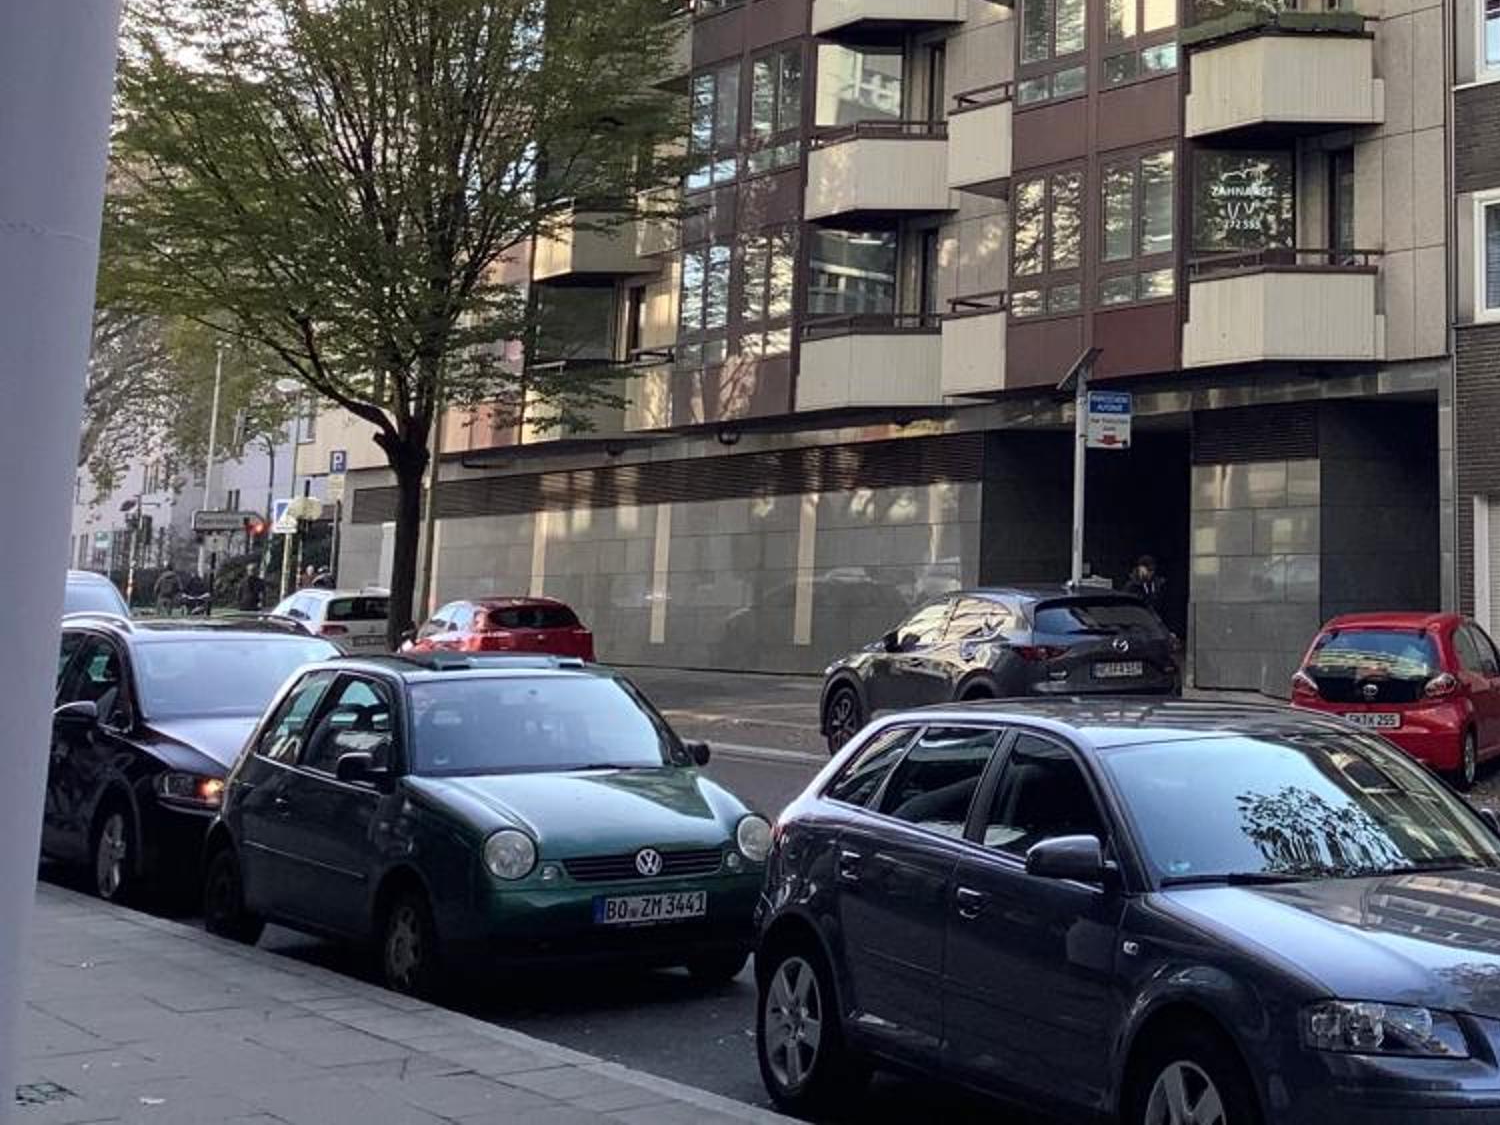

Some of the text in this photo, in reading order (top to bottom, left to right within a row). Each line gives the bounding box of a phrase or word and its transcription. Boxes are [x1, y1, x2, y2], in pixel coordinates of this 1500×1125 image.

[607, 892, 705, 920] BO ZM 3441
